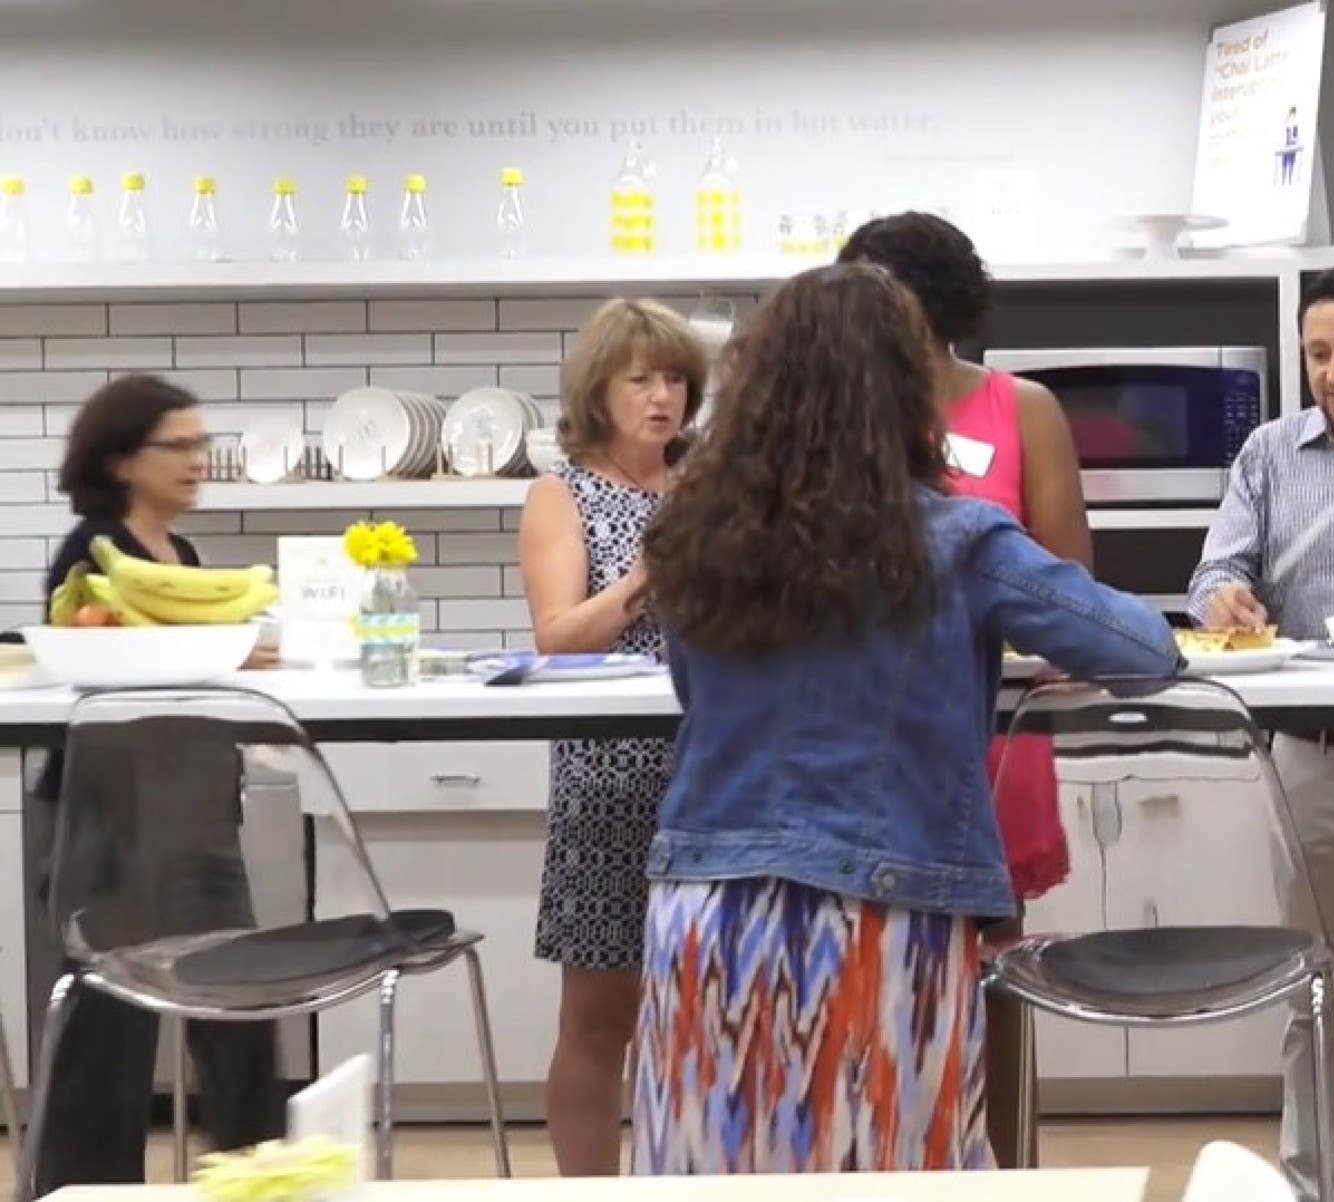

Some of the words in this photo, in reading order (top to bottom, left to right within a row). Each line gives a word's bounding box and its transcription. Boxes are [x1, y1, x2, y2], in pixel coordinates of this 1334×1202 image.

[72, 115, 151, 143] know
[161, 114, 223, 141] how
[232, 118, 328, 145] strong
[339, 112, 400, 144] they
[411, 117, 458, 138] are
[468, 111, 537, 137] until
[547, 117, 598, 143] you
[609, 113, 659, 142] put
[668, 109, 744, 135] them
[755, 107, 782, 133] in
[792, 109, 840, 134] hot
